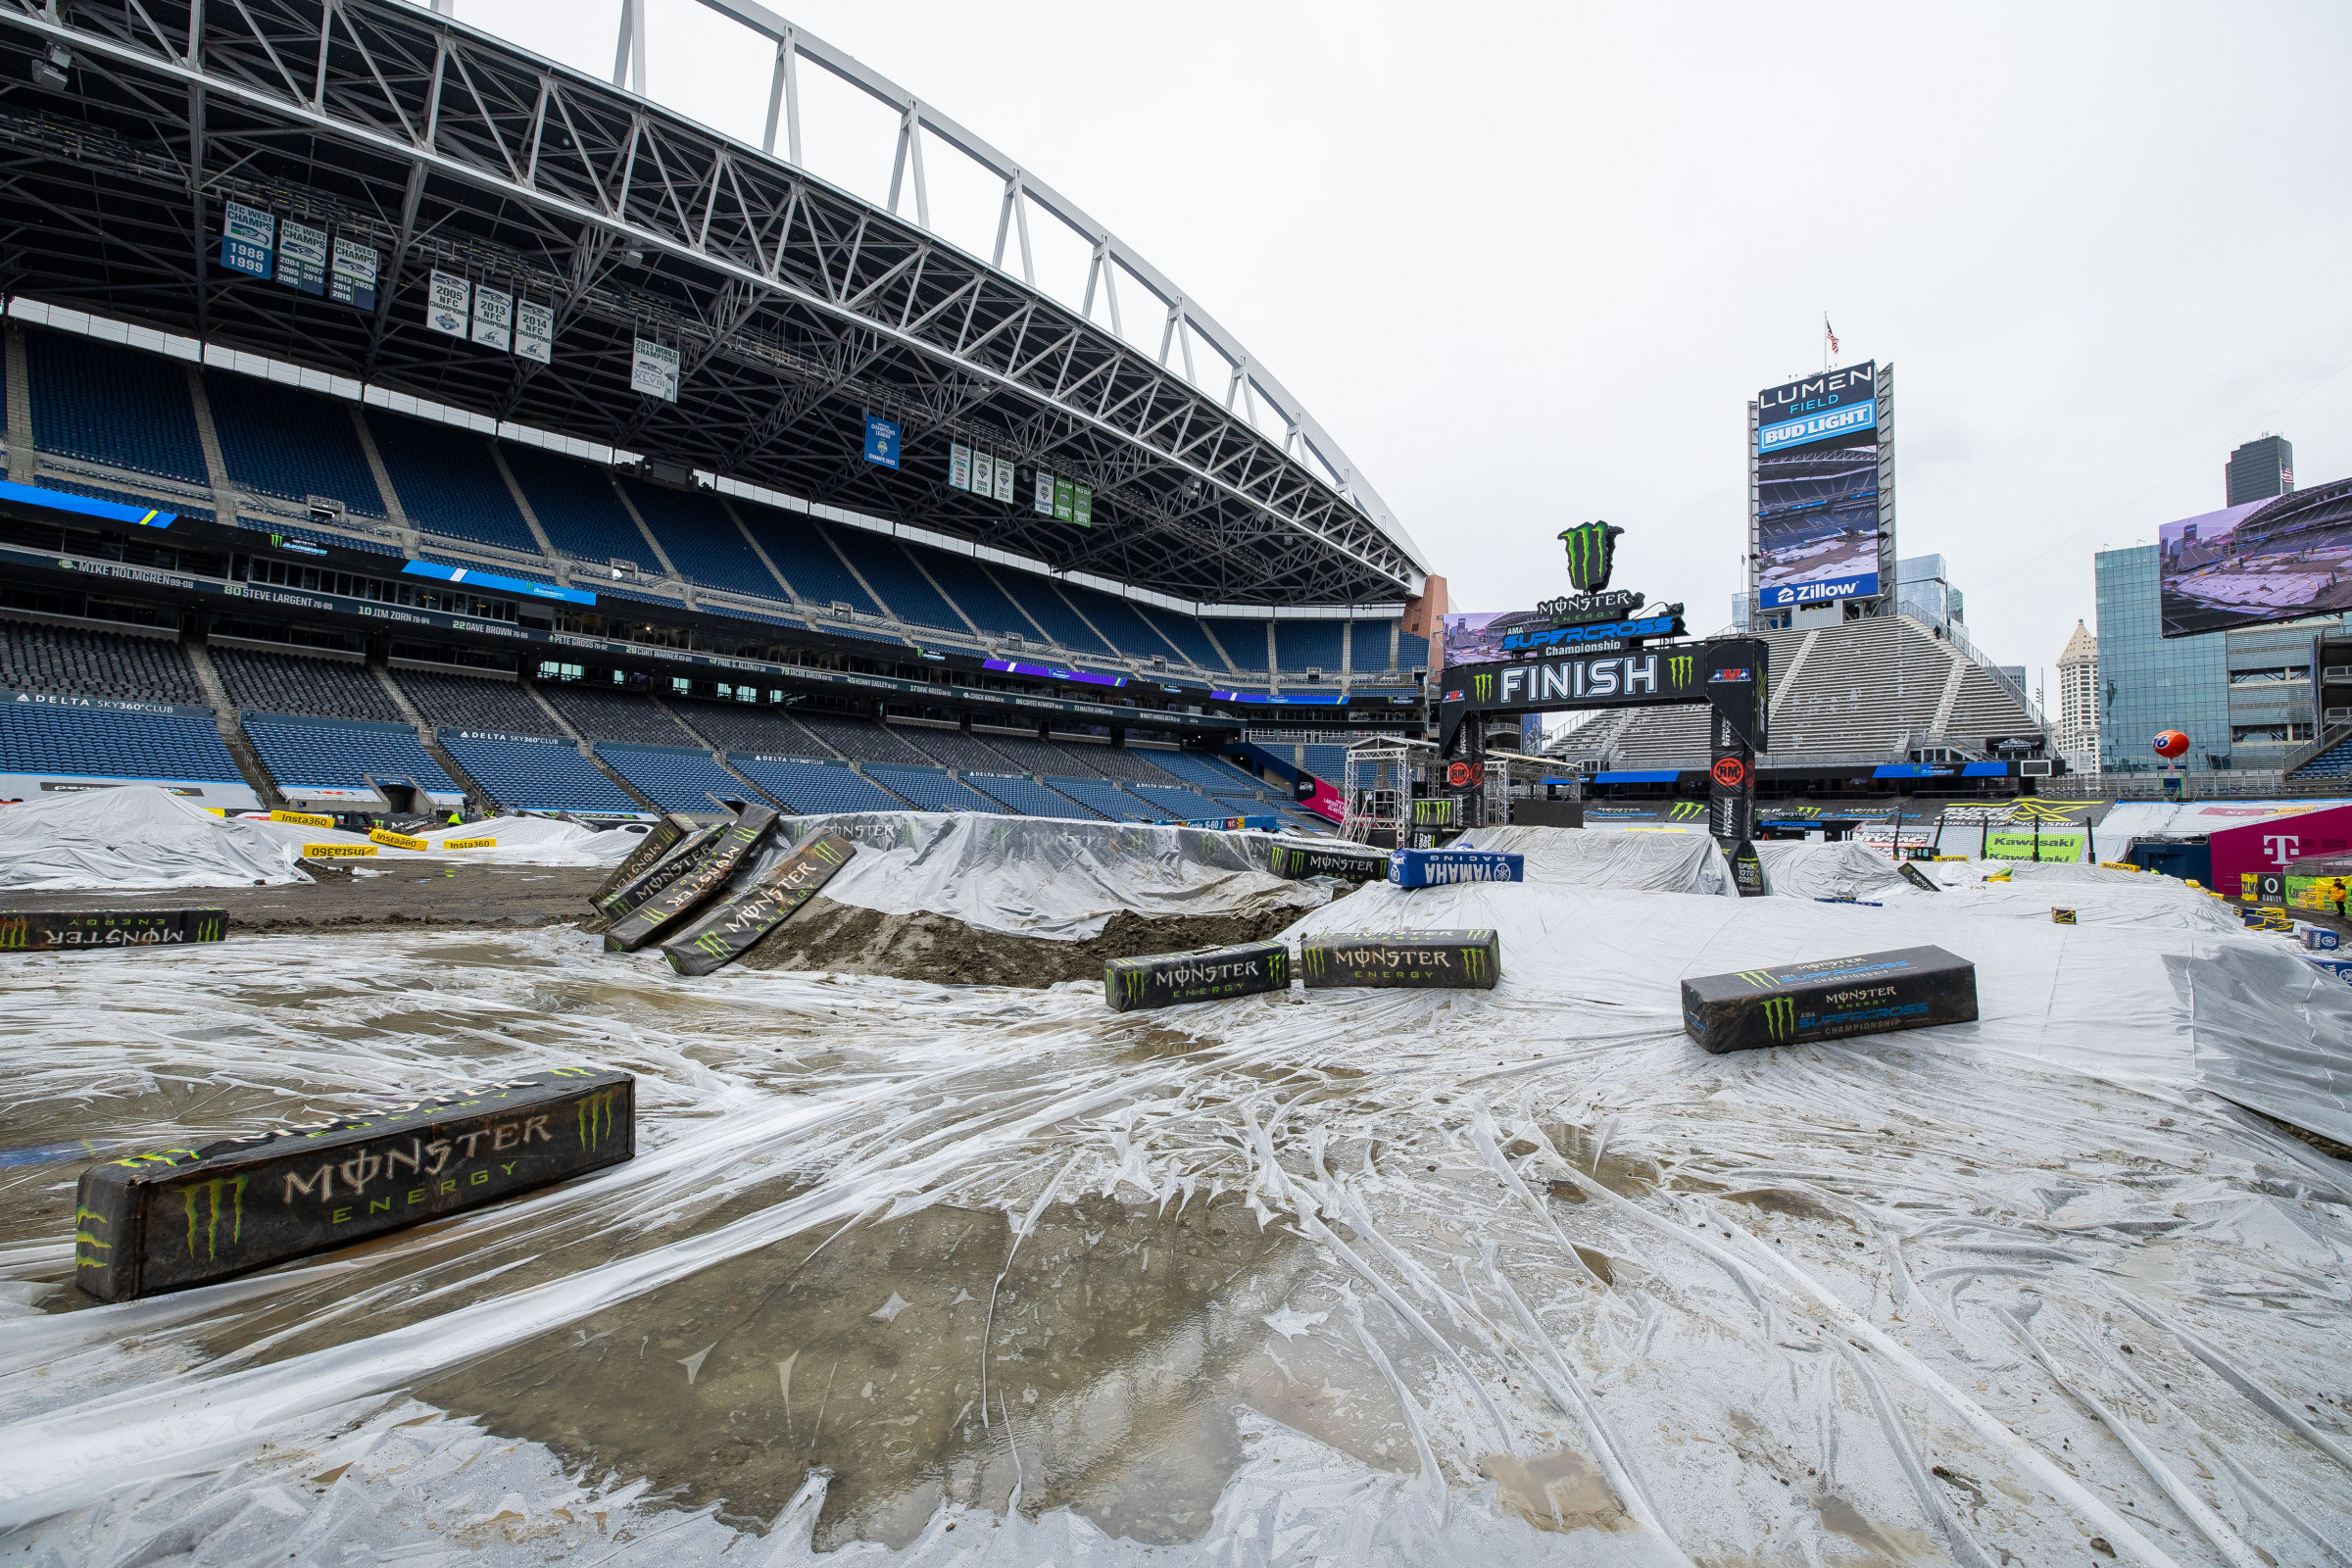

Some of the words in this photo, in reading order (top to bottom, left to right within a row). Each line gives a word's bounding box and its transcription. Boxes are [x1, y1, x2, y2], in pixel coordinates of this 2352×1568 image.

[227, 202, 245, 215] AFC
[248, 209, 272, 223] WEST
[227, 210, 272, 231] CHAMPS
[283, 220, 300, 233] NFC
[303, 227, 326, 241] WEST
[282, 228, 325, 250] CHAMPS
[230, 242, 265, 262] 1988
[335, 247, 376, 266] CHAMPS
[336, 239, 353, 250] NFC
[354, 245, 377, 258] WEST
[229, 255, 264, 273] 1999
[279, 256, 300, 268] 2004
[304, 264, 323, 275] 2007
[278, 265, 299, 276] 2005
[303, 272, 323, 284] 2010
[333, 273, 352, 284] 2013
[278, 273, 299, 285] 2006
[355, 279, 373, 291] 2020
[332, 290, 351, 301] 2016
[333, 282, 351, 293] 2014
[436, 285, 463, 301] 2005
[429, 301, 467, 318] CHAMPIONS
[439, 296, 459, 308] NFC
[480, 300, 506, 316] 2013
[474, 315, 510, 330] CHAMPIONS
[483, 311, 502, 322] NFC
[522, 315, 547, 328] 2014
[517, 329, 551, 344] CHAMPIONS
[525, 324, 543, 335] NFC
[635, 347, 677, 365] CHAMPIONS
[636, 339, 654, 351] 2013
[655, 345, 678, 359] WORLD
[1760, 366, 1872, 410] LUMEN
[1789, 394, 1839, 415] FIELD
[1765, 421, 1806, 444] BUD
[1808, 409, 1868, 435] LIGHT
[868, 453, 885, 463] CHAMPS
[886, 458, 896, 466] 2022
[78, 562, 110, 576] MIKE
[112, 566, 170, 586] HOLMGREN
[170, 578, 194, 589] 99-08
[224, 585, 241, 597] 80
[242, 588, 271, 602] STEVE
[272, 592, 313, 608] LARGENT
[1796, 582, 1857, 602] Zillow
[1538, 591, 1630, 616] MONSTER
[358, 606, 371, 616] 10
[372, 608, 389, 619] JIM
[390, 610, 413, 622] ZORN
[1552, 610, 1616, 624] ENERGY
[453, 620, 466, 630] 22
[466, 622, 484, 634] DAVE
[485, 624, 513, 637] BROWN
[1502, 615, 1675, 651] SUPERCROSS
[1507, 626, 1524, 636] AMA
[555, 636, 571, 647] PETE
[571, 637, 594, 649] GROSS
[1545, 641, 1621, 657] Championship
[626, 646, 637, 655] 28
[637, 647, 653, 657] CURT
[654, 650, 678, 661] WARNER
[717, 659, 732, 667] PAUL
[738, 662, 755, 670] ALLEN
[789, 668, 805, 678] JACOB
[806, 671, 822, 680] GREEN
[1501, 656, 1658, 703] FINISH
[1708, 668, 1752, 683] AMA
[35, 695, 90, 707] DELTA
[1443, 689, 1465, 704] AMA
[471, 731, 506, 741] DELTA
[281, 813, 327, 827] Insta360
[376, 833, 417, 848] Insta360
[450, 840, 490, 849] Insta360
[312, 847, 365, 857] Insta360
[635, 844, 712, 901] MONSTER
[1309, 856, 1374, 873] MONSTER
[2102, 862, 2134, 871] SUZUKI
[1424, 862, 1493, 884] YAMAHA
[725, 861, 817, 933] MONSTER
[2262, 894, 2282, 903] OAKLEY
[757, 882, 814, 932] ENERGY
[46, 928, 184, 946] MONSTER
[1335, 950, 1451, 967] MONSTER
[1797, 956, 1867, 971] MONSTER
[1156, 960, 1260, 988] MONSTER
[1354, 970, 1435, 980] ENERGY
[1779, 960, 1910, 983] SUPERCROSS
[1814, 969, 1889, 985] CHAMPIONSHIP
[1173, 983, 1245, 999] ENERGY
[1826, 986, 1897, 1004] MONSTER
[1838, 999, 1887, 1010] ENERGY
[1797, 1003, 1930, 1029] SUPERCROSS
[1825, 1018, 1902, 1035] CHAMPIONSHIP
[281, 1114, 554, 1205] MONSTER
[333, 1160, 518, 1225] ENERGY
